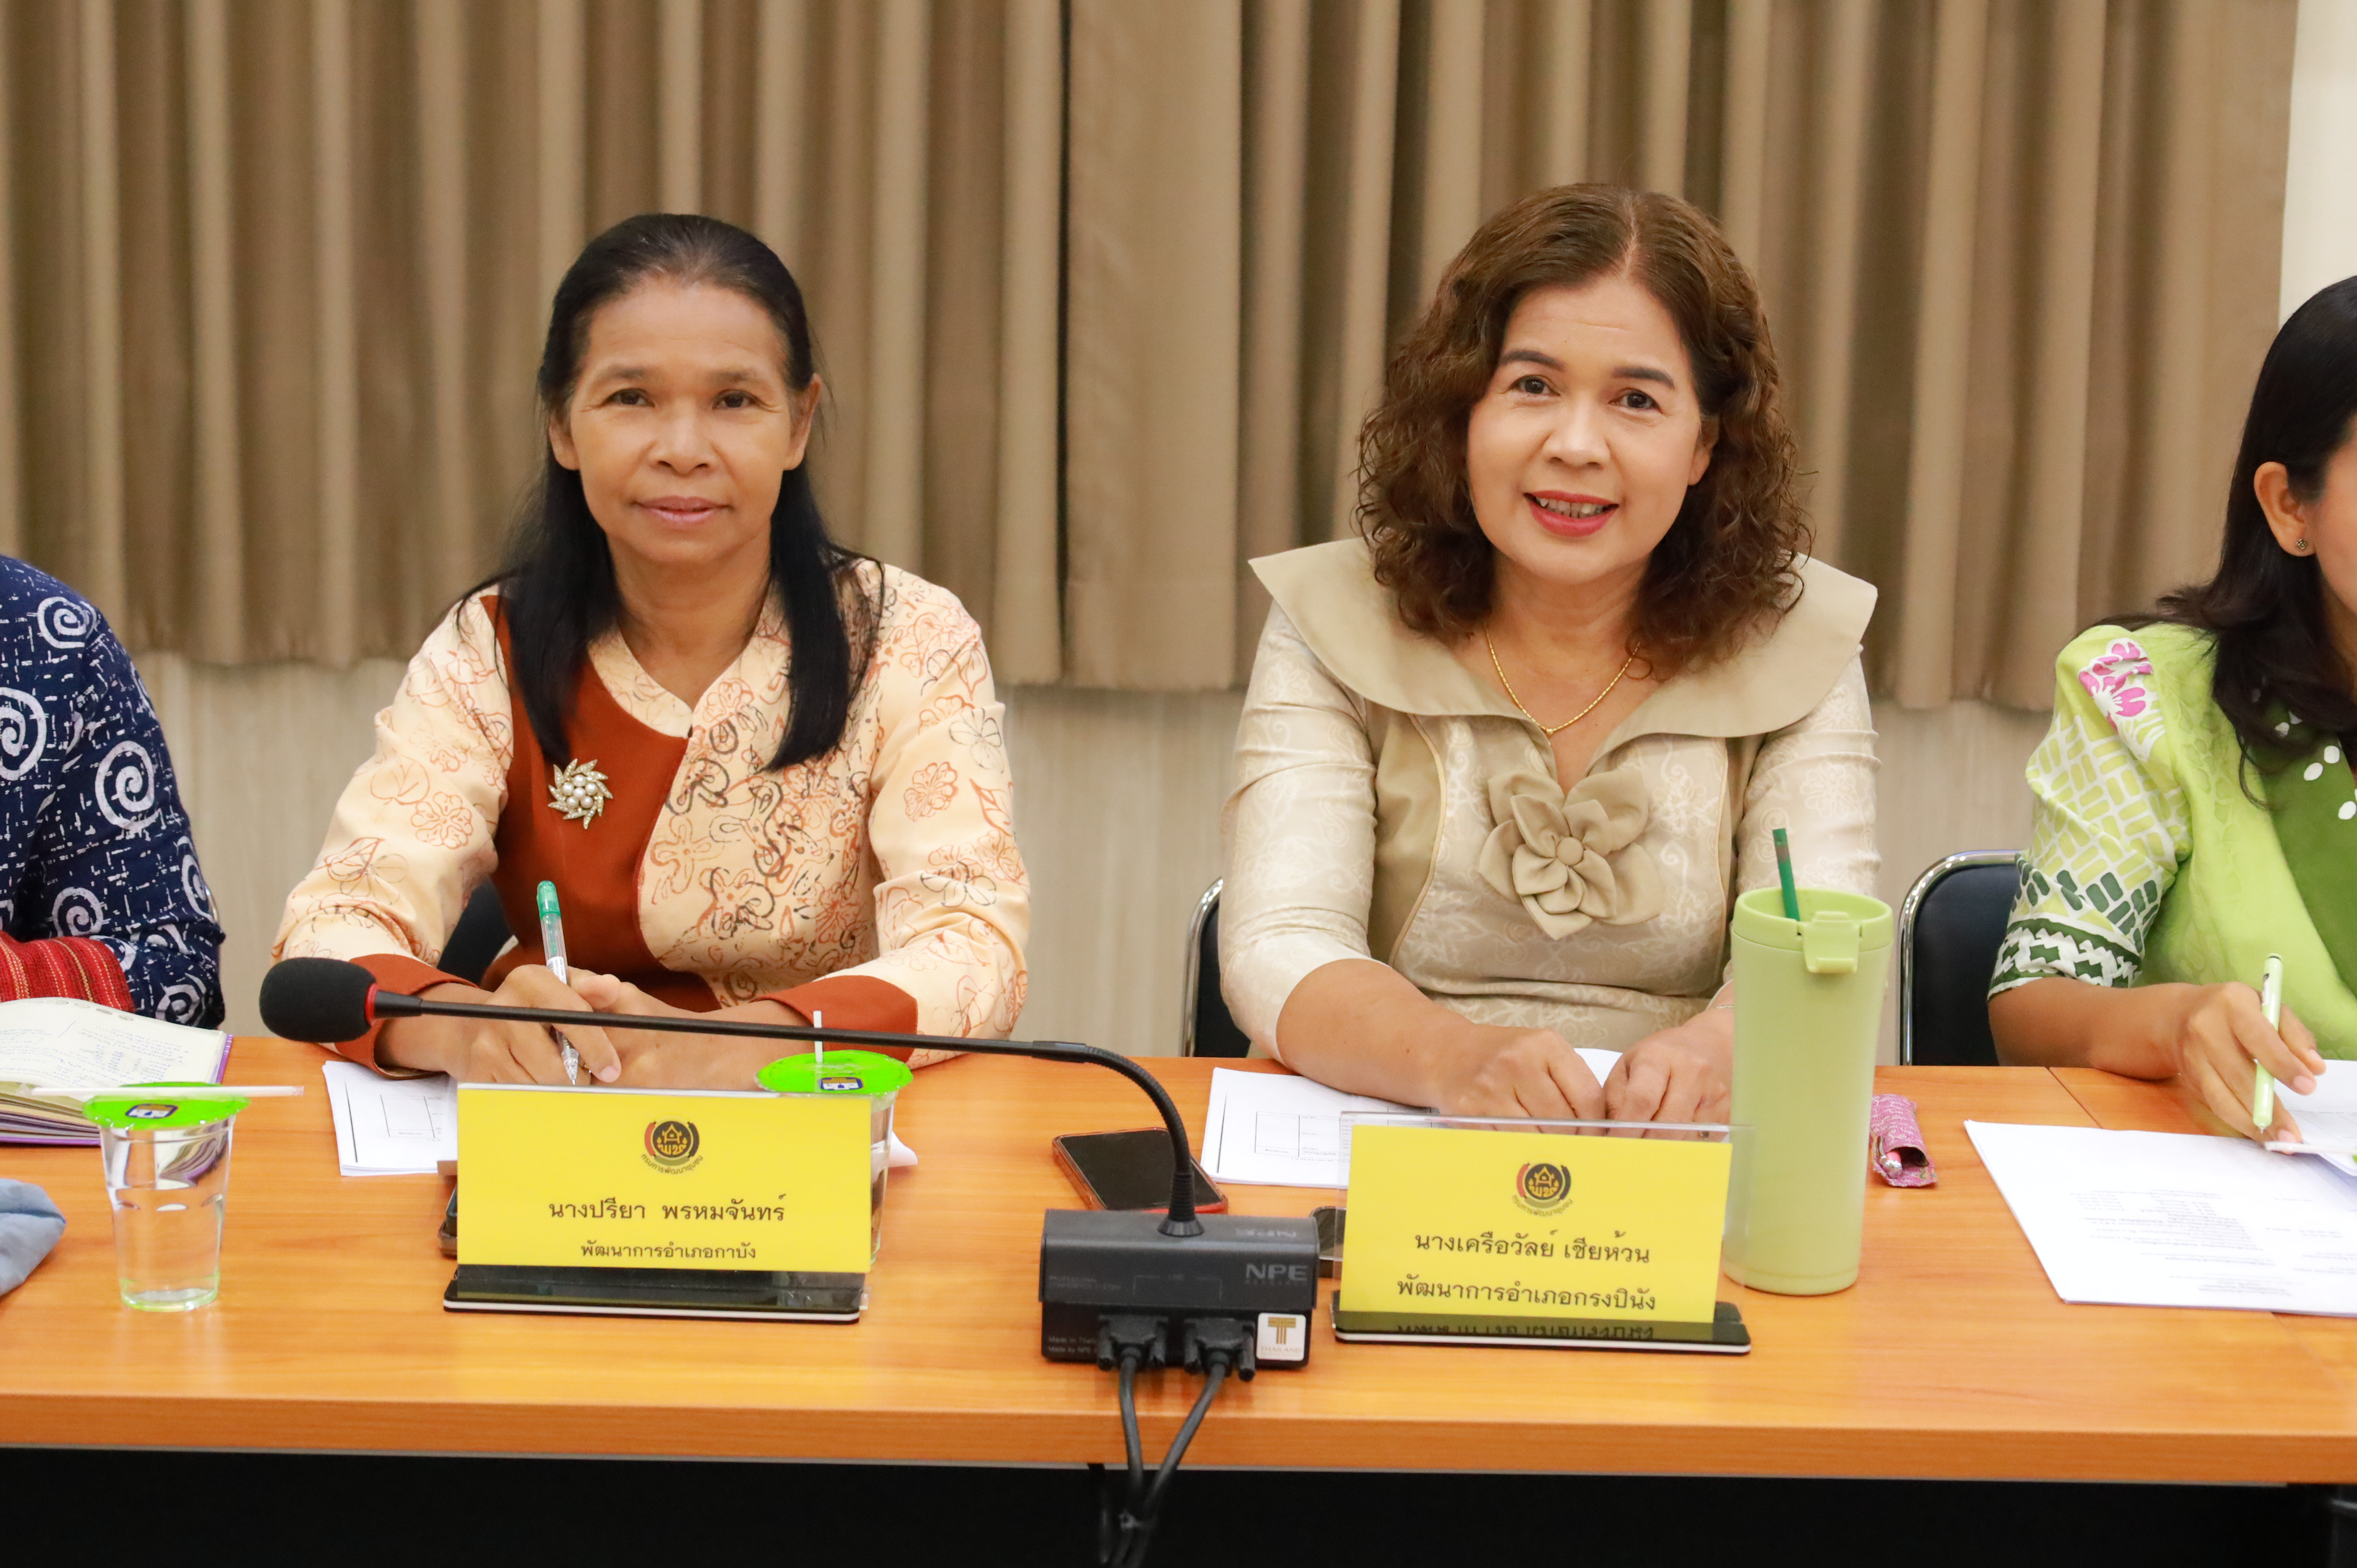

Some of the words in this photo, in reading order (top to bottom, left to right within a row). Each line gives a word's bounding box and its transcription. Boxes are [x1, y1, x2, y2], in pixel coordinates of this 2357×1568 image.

[549, 1196, 646, 1219] นางปรียา
[662, 1193, 786, 1221] พรหมจันทร์
[581, 1239, 756, 1259] พัฒนาการอำเภอกาบัง
[1415, 1229, 1558, 1257] นางเครือวัลย์
[1564, 1230, 1649, 1263] เชียห้วน
[1246, 1263, 1308, 1281] NPE
[1397, 1273, 1656, 1310] พัฒนาการอำเภอกรงปินัง
